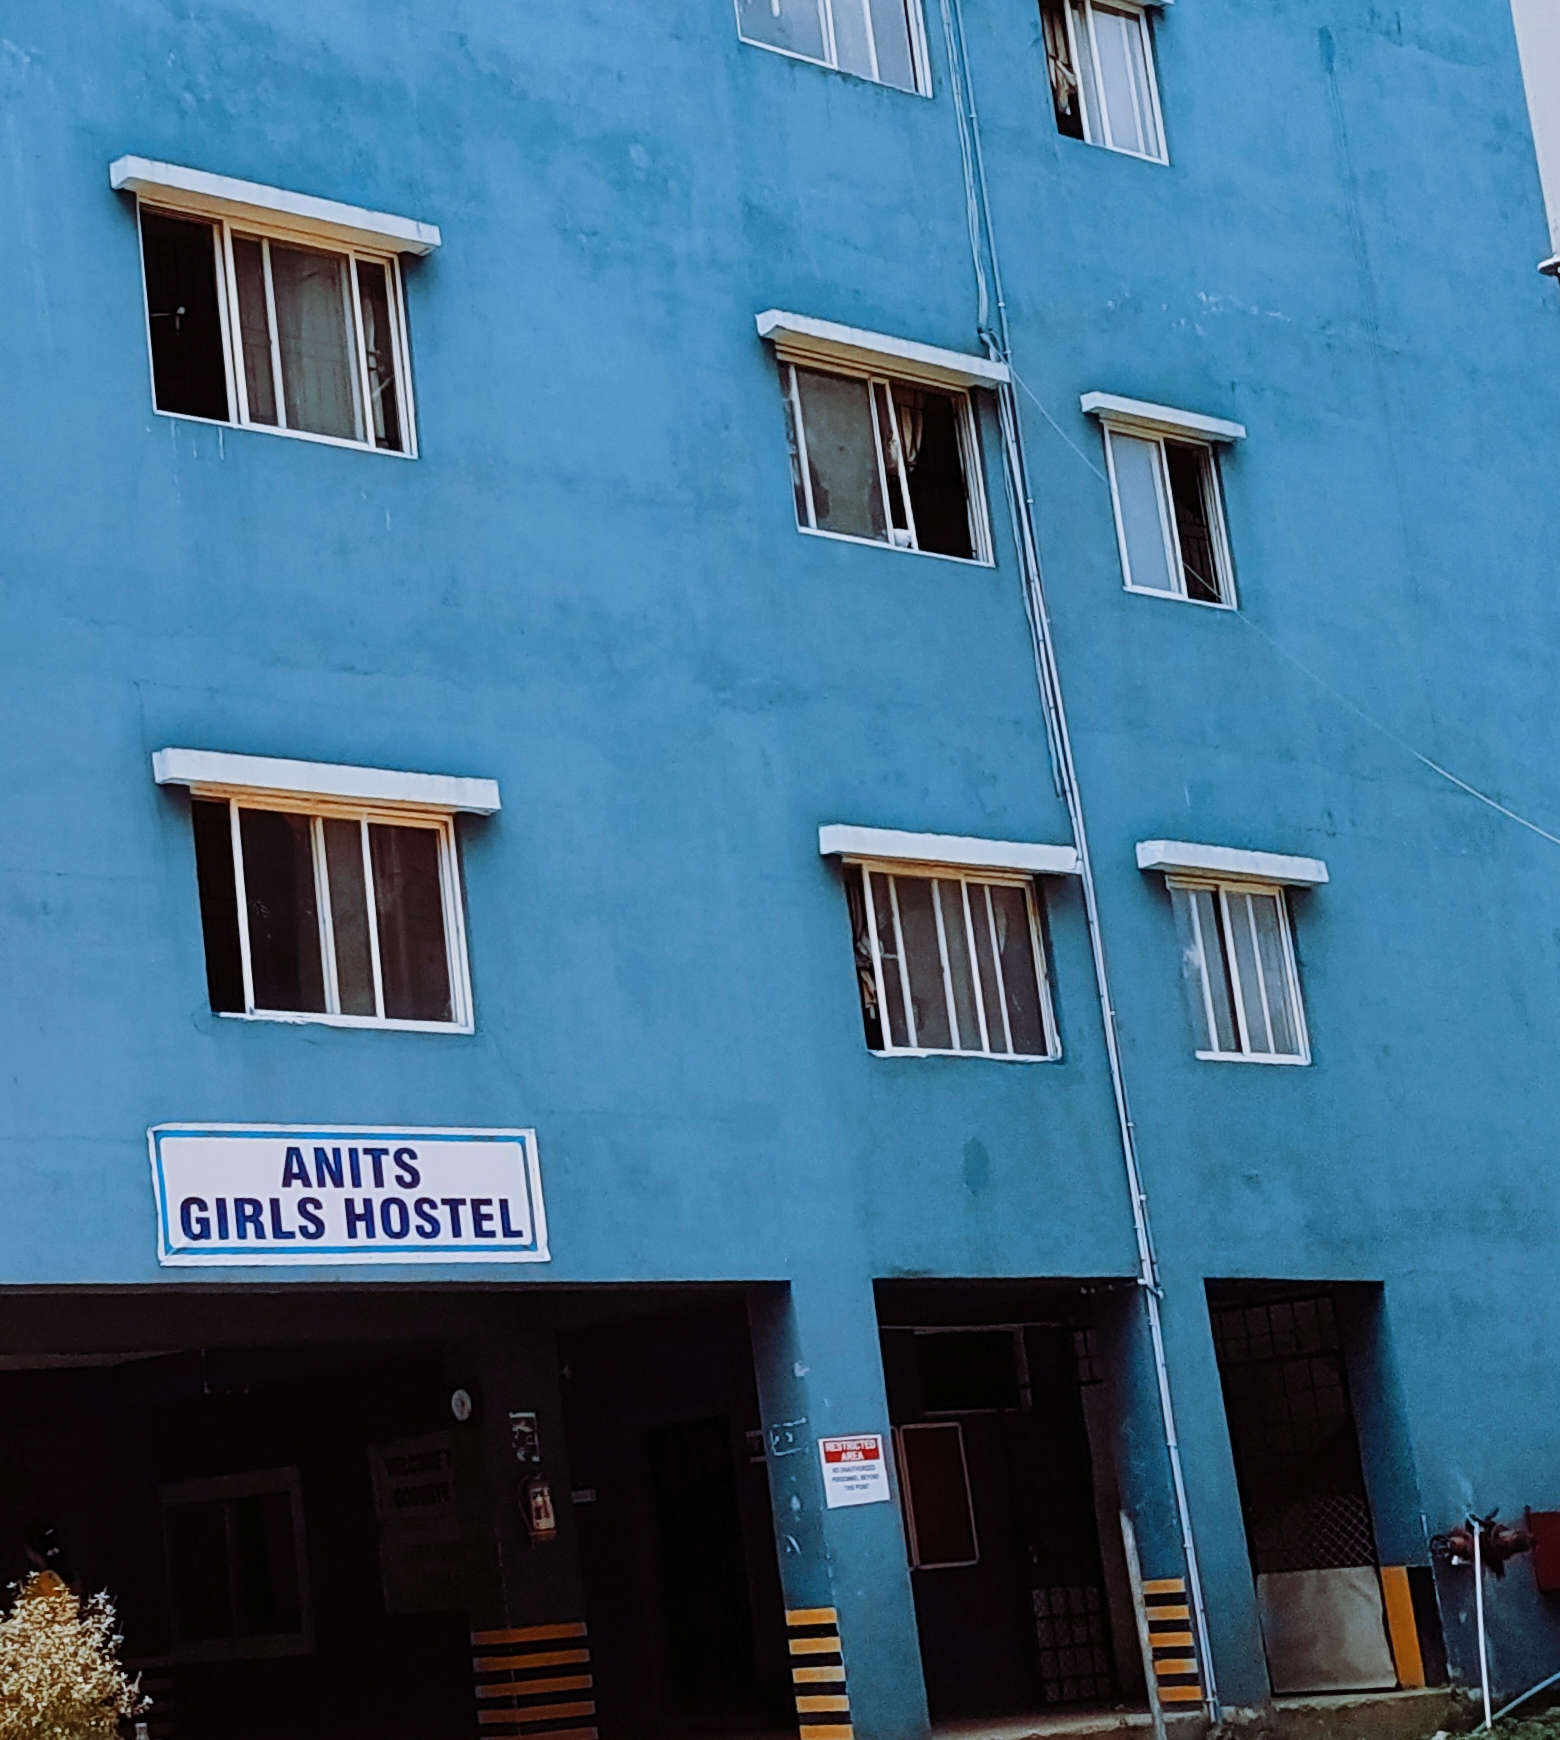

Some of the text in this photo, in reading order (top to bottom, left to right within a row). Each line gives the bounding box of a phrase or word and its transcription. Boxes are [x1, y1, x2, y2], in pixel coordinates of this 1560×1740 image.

[281, 1146, 421, 1190] ANITS
[179, 1196, 523, 1241] GIRLS HOSTEL
[825, 1440, 876, 1452] RESTRICTED
[841, 1451, 865, 1461] AREA
